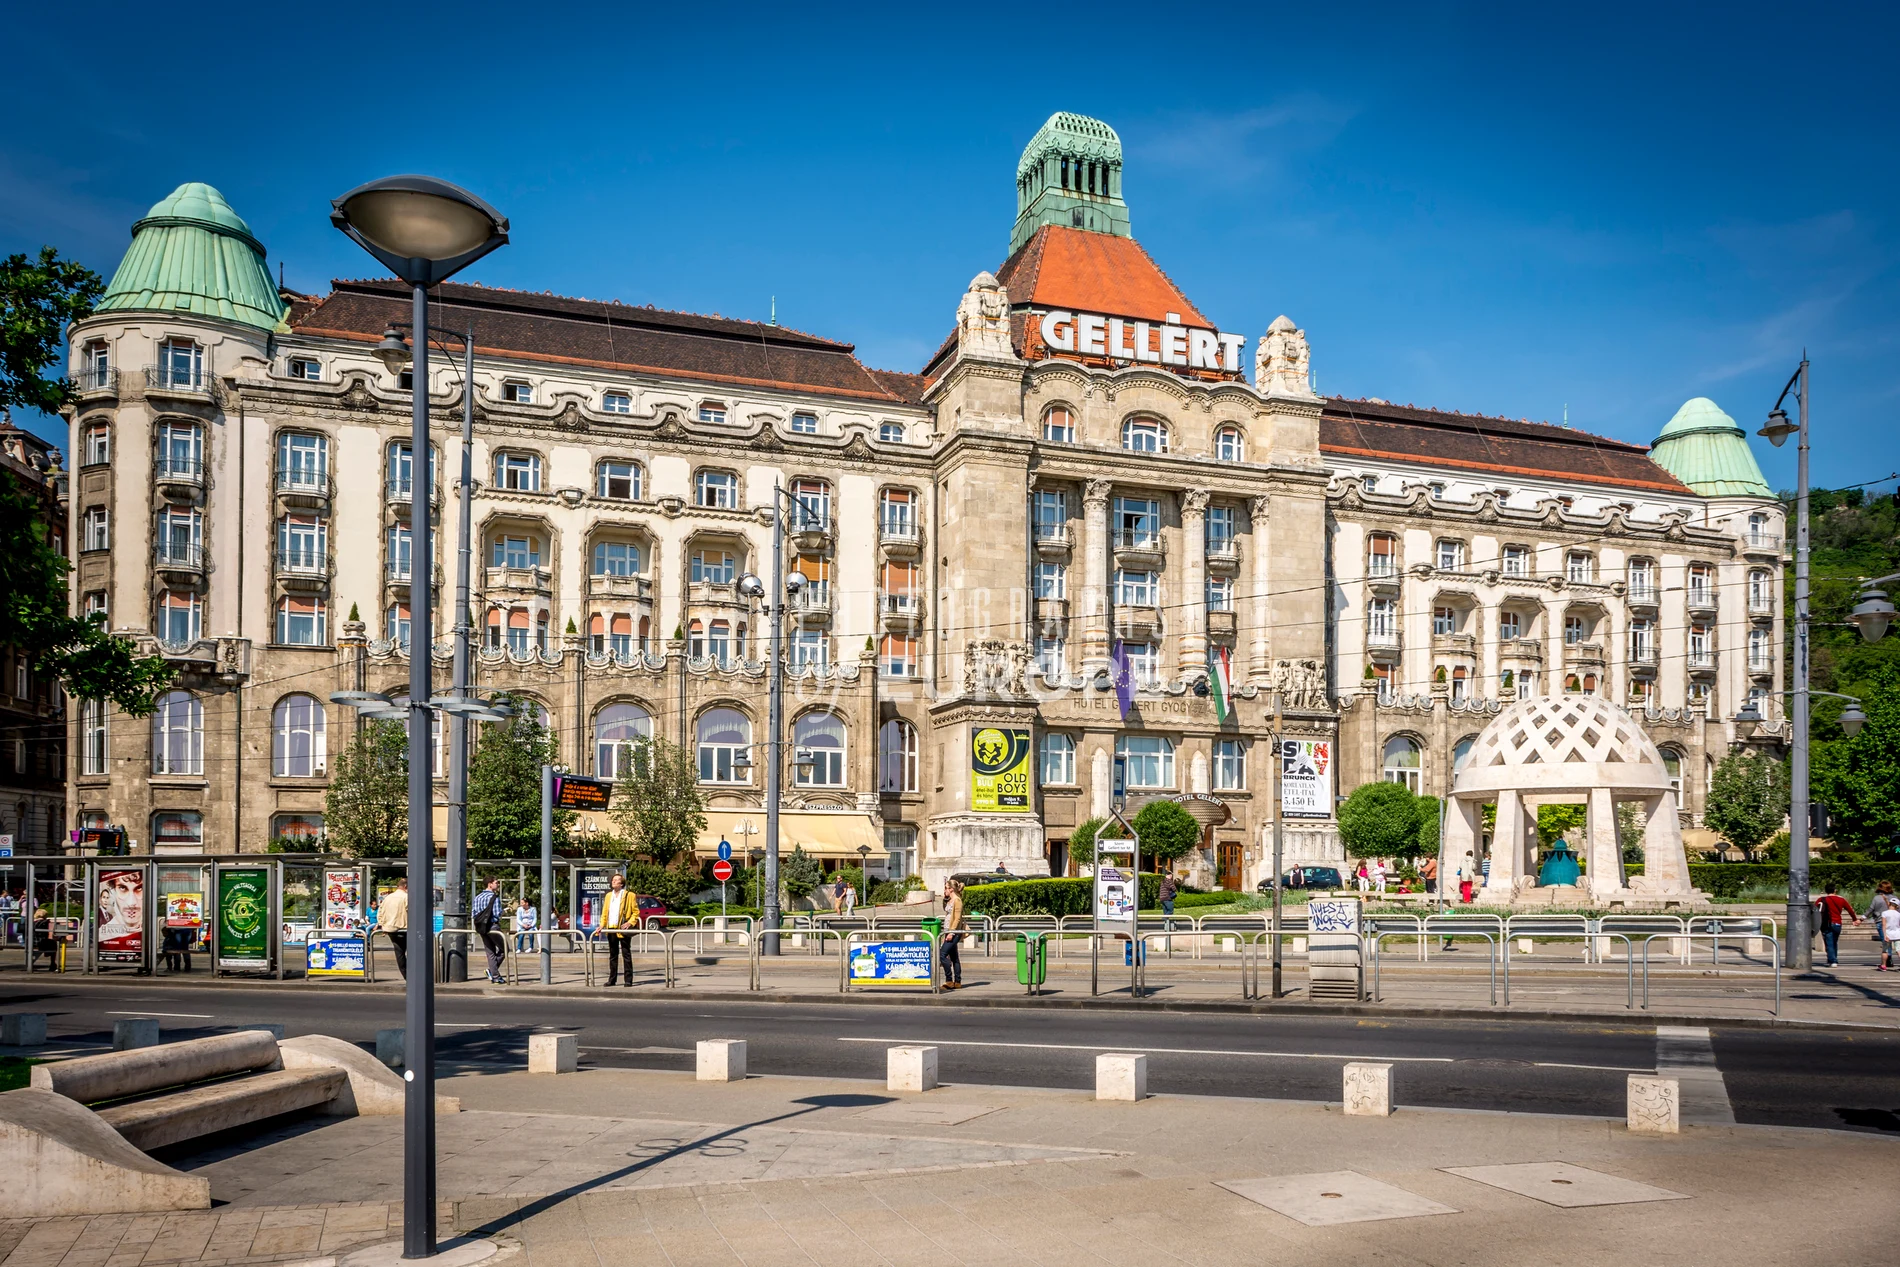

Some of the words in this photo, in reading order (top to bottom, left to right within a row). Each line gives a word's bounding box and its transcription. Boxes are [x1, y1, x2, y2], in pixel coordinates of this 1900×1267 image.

[1073, 698, 1107, 710] HOTEL
[1003, 773, 1027, 783] OLD
[997, 784, 1027, 793] BOYS
[1172, 794, 1195, 803] HOTEL
[1284, 796, 1305, 806] 5.450
[1307, 797, 1315, 806] Ft
